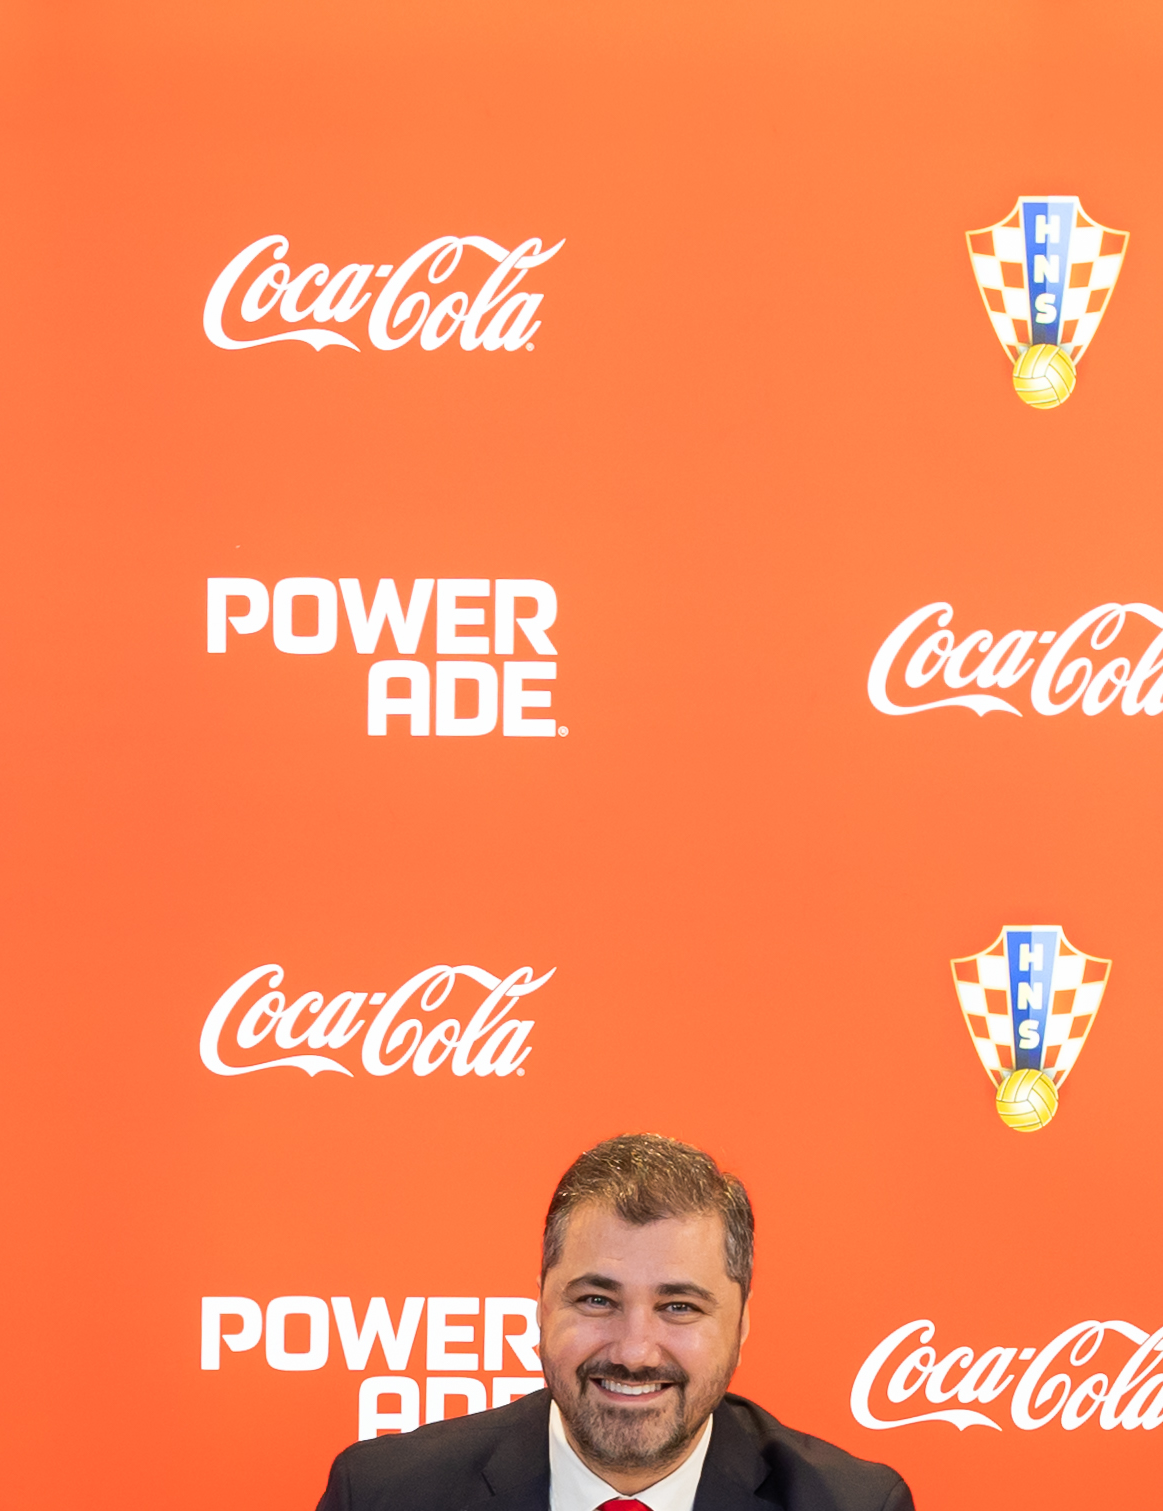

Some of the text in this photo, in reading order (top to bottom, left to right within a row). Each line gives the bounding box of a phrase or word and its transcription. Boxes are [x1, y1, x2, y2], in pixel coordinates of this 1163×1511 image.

[203, 235, 566, 352] Coca-Cola
[1034, 214, 1060, 324] HNS
[207, 577, 558, 656] POWER
[367, 660, 558, 737] ADE
[199, 963, 557, 1078] Coca-Cola
[1018, 943, 1044, 1050] HNS
[200, 1295, 544, 1371] POWER
[850, 1319, 1163, 1432] Coca-Cola
